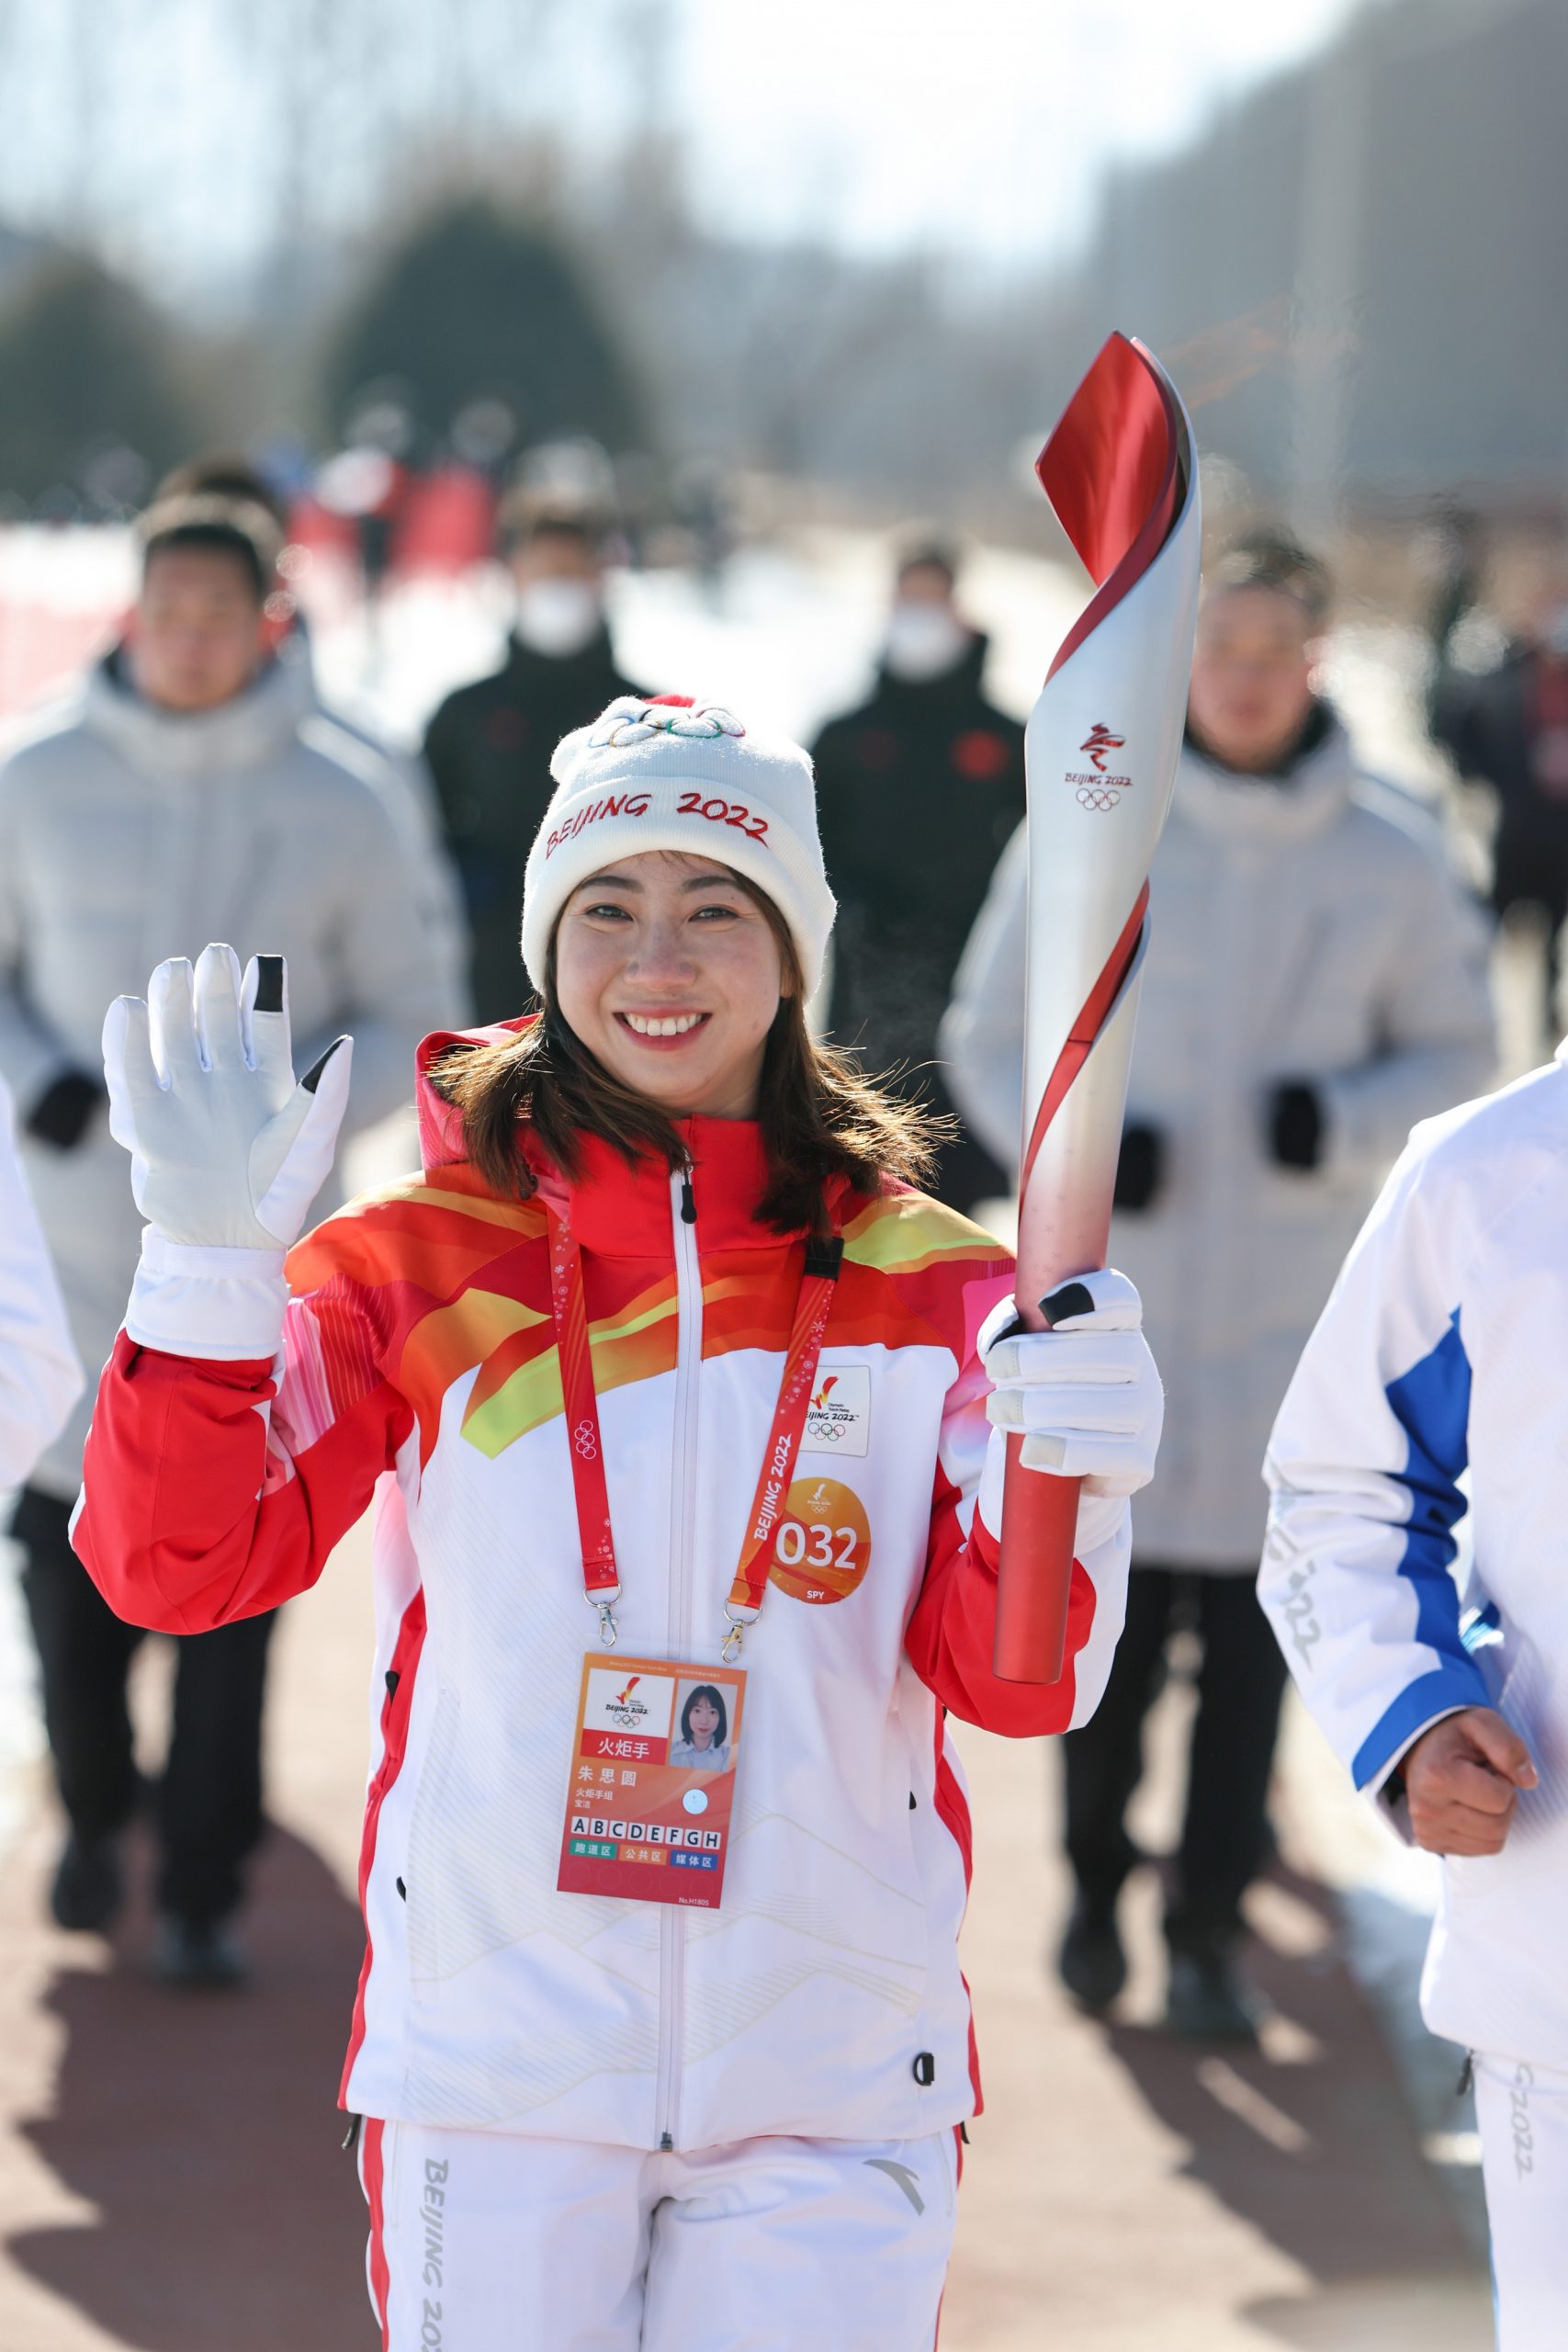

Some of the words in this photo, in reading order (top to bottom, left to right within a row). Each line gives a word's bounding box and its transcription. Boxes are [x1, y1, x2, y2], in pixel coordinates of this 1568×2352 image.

[1065, 773, 1102, 786] BEIJING
[1105, 775, 1133, 786] 2022
[546, 793, 651, 860] BEIJING
[676, 792, 770, 848] 2022
[753, 1480, 782, 1541] BEIJING
[772, 1433, 792, 1477] 2022
[775, 1521, 857, 1569] 032
[807, 1590, 824, 1600] SPY
[605, 1704, 629, 1713] BEIJING
[597, 1737, 649, 1758] 火炬手
[575, 1787, 614, 1801] 火炬手组
[574, 1842, 611, 1856] 跑道区
[625, 1849, 661, 1862] 公共区
[675, 1854, 712, 1868] 媒体区
[1509, 2090, 1534, 2181] 2022
[420, 2157, 449, 2289] BEIJING
